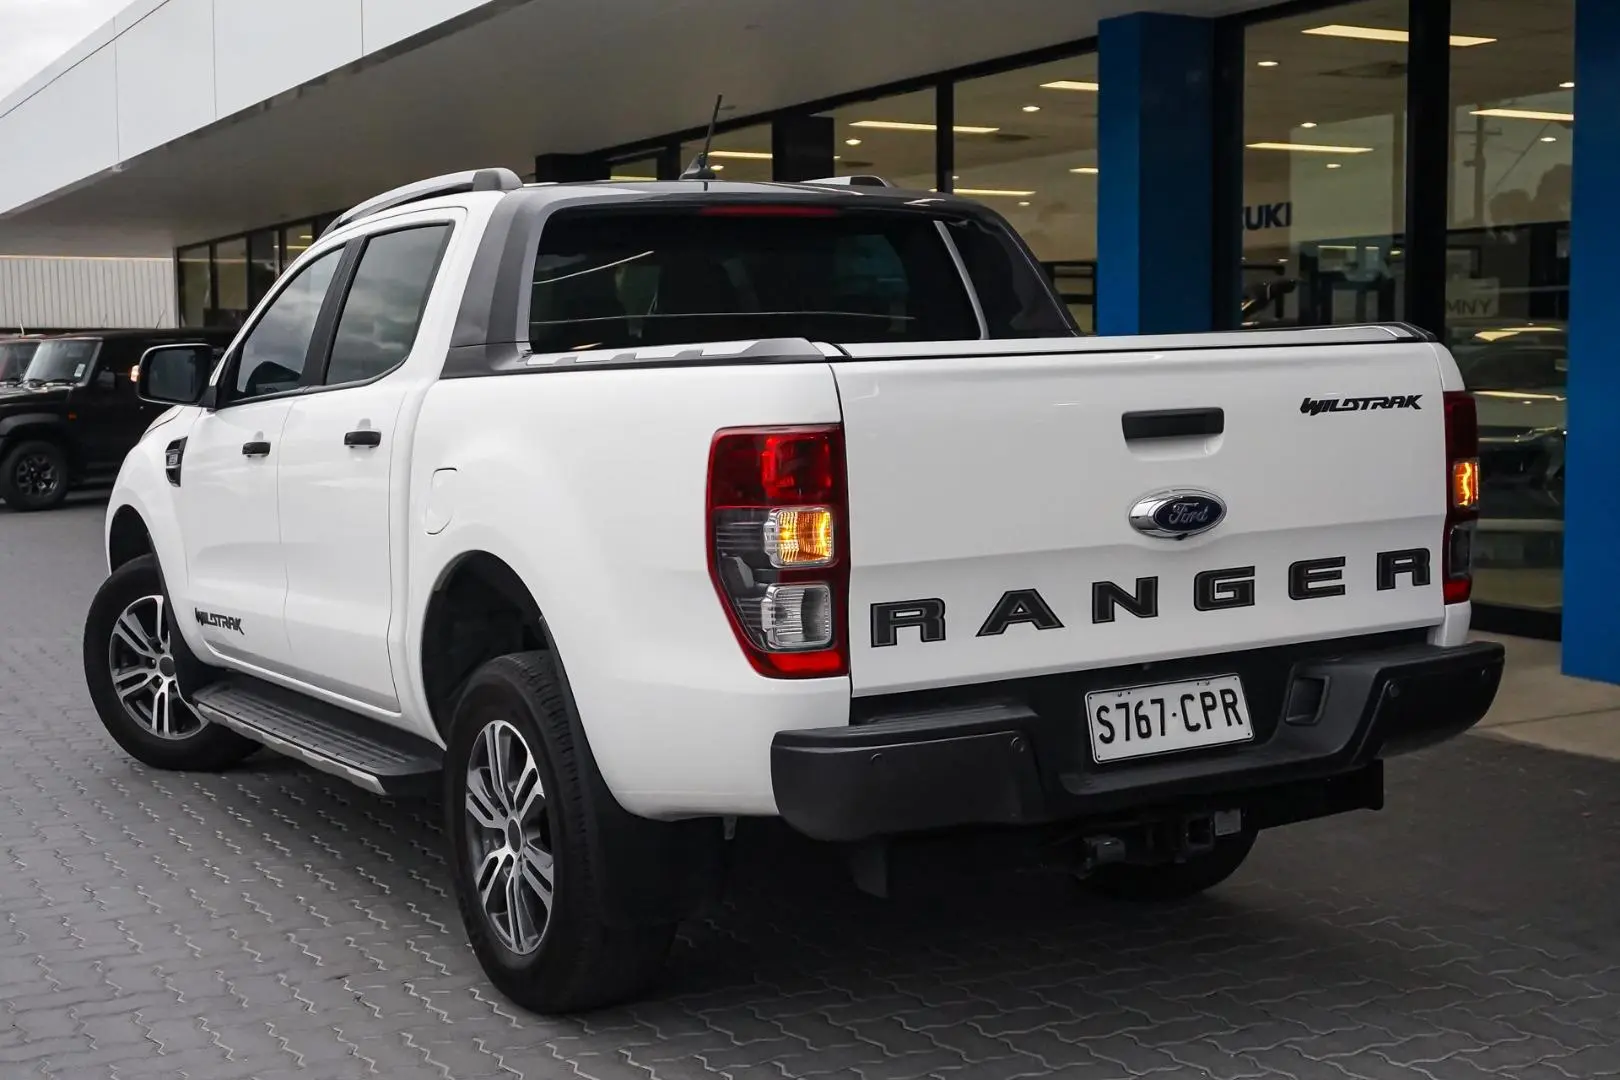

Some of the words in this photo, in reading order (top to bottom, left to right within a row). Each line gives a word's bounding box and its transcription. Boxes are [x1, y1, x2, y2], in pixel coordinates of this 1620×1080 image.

[1243, 202, 1291, 230] UKI
[1300, 395, 1423, 416] WILDTRAK
[1168, 502, 1209, 524] Ford
[870, 548, 1431, 647] RANGER
